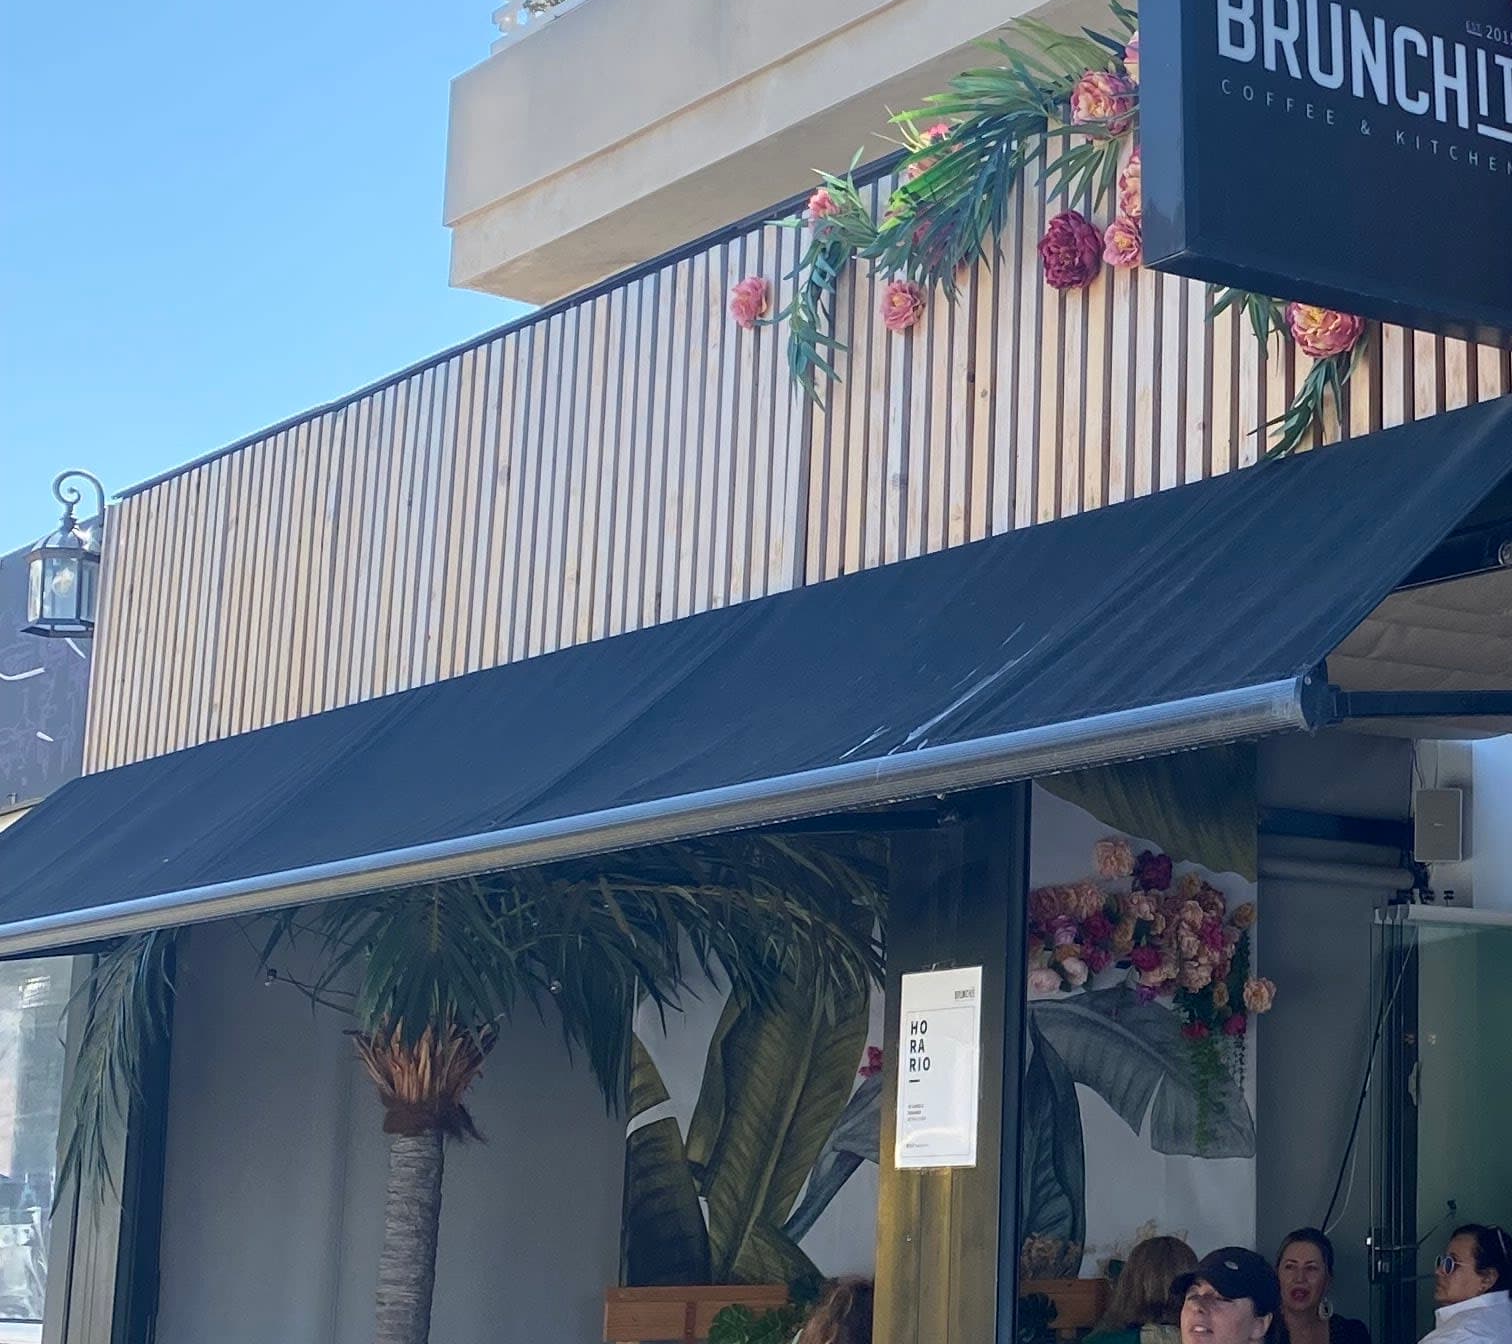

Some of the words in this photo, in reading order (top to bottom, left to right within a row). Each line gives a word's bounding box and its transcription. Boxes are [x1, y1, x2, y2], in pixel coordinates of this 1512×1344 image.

[1221, 78, 1336, 126] COFFEE
[1360, 119, 1372, 135] &
[910, 1020, 928, 1036] HO
[909, 1039, 925, 1054] RA
[909, 1057, 931, 1072] RIO
